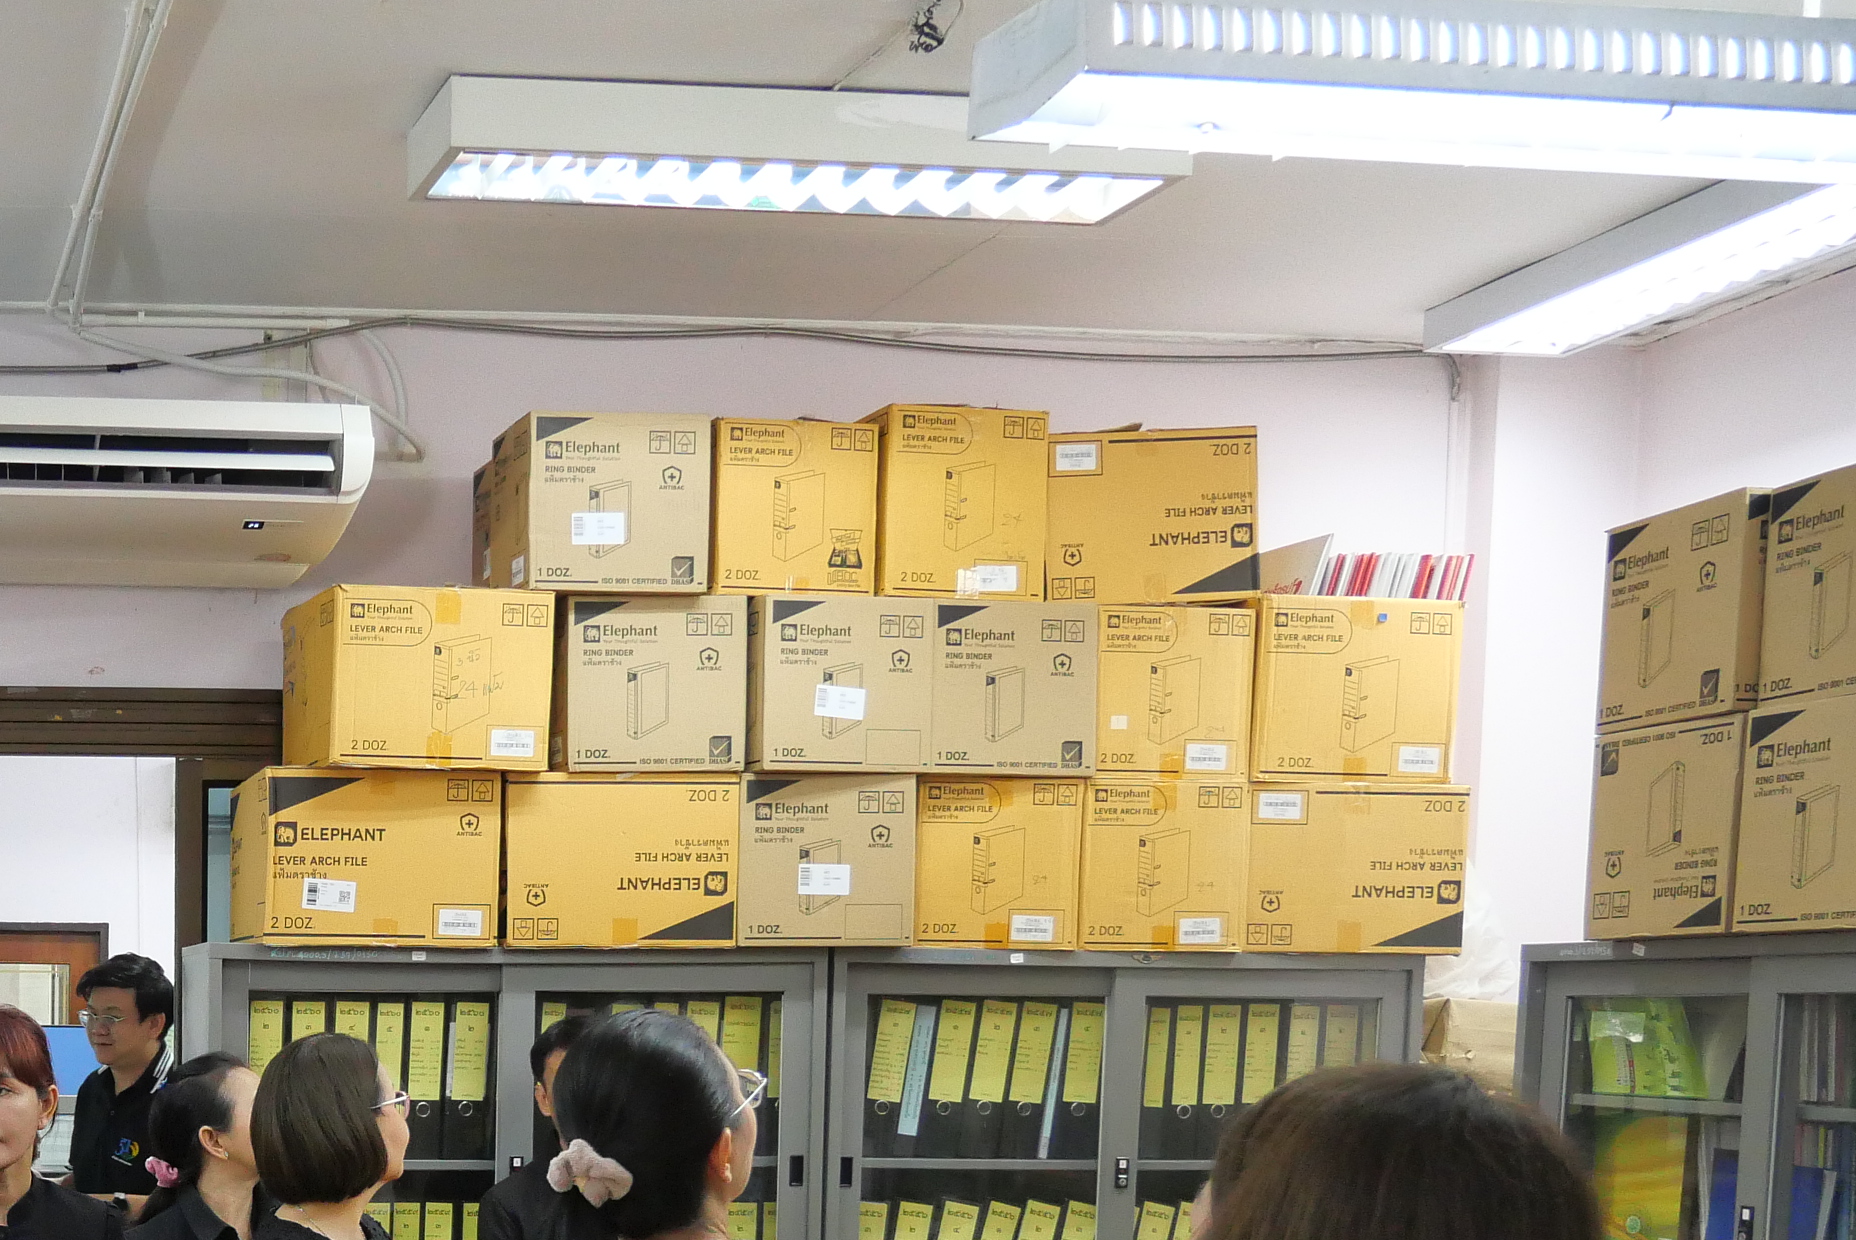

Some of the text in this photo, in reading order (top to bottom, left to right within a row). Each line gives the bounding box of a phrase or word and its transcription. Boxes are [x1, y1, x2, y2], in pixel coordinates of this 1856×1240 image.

[917, 415, 956, 428] Elephant
[745, 427, 785, 439] Elephant
[902, 434, 966, 444] LEVER ARCH FILE
[565, 441, 620, 457] Elephant
[730, 446, 794, 457] LEVER ARCH FILE
[545, 465, 596, 474] RING BINDER
[1164, 505, 1253, 518] LEVER ARCH FILE
[1796, 505, 1844, 531] Elephant
[1149, 530, 1227, 546] ELEPHANT
[1776, 543, 1822, 561] RING BINDER
[1628, 546, 1669, 571] Elephant
[546, 567, 572, 577] DOZ.
[725, 569, 732, 579] 2
[900, 572, 908, 583] 2
[367, 603, 413, 616] Elephant
[1122, 615, 1162, 627] Elephant
[1290, 613, 1334, 625] Elephant
[350, 624, 423, 635] LEVER ARCH FILE
[603, 623, 658, 638] Elephant
[800, 623, 852, 638] Elephant
[964, 628, 1015, 643] Elephant
[583, 648, 634, 657] RING BINDER
[780, 648, 829, 657] RING BINDER
[945, 652, 993, 660] RING BINDER
[1771, 678, 1792, 691] DOZ.
[1606, 705, 1624, 716] DOZ.
[351, 739, 358, 750] 2
[1776, 738, 1831, 759] Elephant
[584, 748, 611, 759] DOZ.
[782, 748, 806, 758] DOZ.
[945, 751, 970, 761] DOZ.
[1100, 753, 1107, 763] 2
[1277, 757, 1285, 768] 2
[1755, 772, 1805, 785] RING BINDER
[722, 789, 730, 801] 2
[943, 786, 984, 797] Elephant
[1109, 788, 1150, 800] Elephant
[775, 802, 829, 816] Elephant
[928, 805, 993, 813] LEVER ARCH FILE
[1094, 807, 1158, 816] LEVER ARCH FILE
[301, 827, 386, 842] ELEPHANT
[755, 826, 774, 834] RING
[273, 856, 368, 866] LEVER ARCH FILE
[635, 853, 729, 862] LEVER ARCH FILE
[1370, 861, 1463, 871] LEVER ARCH FILE
[272, 868, 328, 880] แฟ้มตราช้าง
[617, 877, 701, 890] ELEPHANT
[1352, 885, 1434, 898] ELEPHANT
[1653, 882, 1699, 900] Elephant
[1748, 903, 1772, 916] DOZ.
[271, 917, 279, 928] 2
[757, 924, 783, 934] DOZ.
[921, 924, 929, 933] 2
